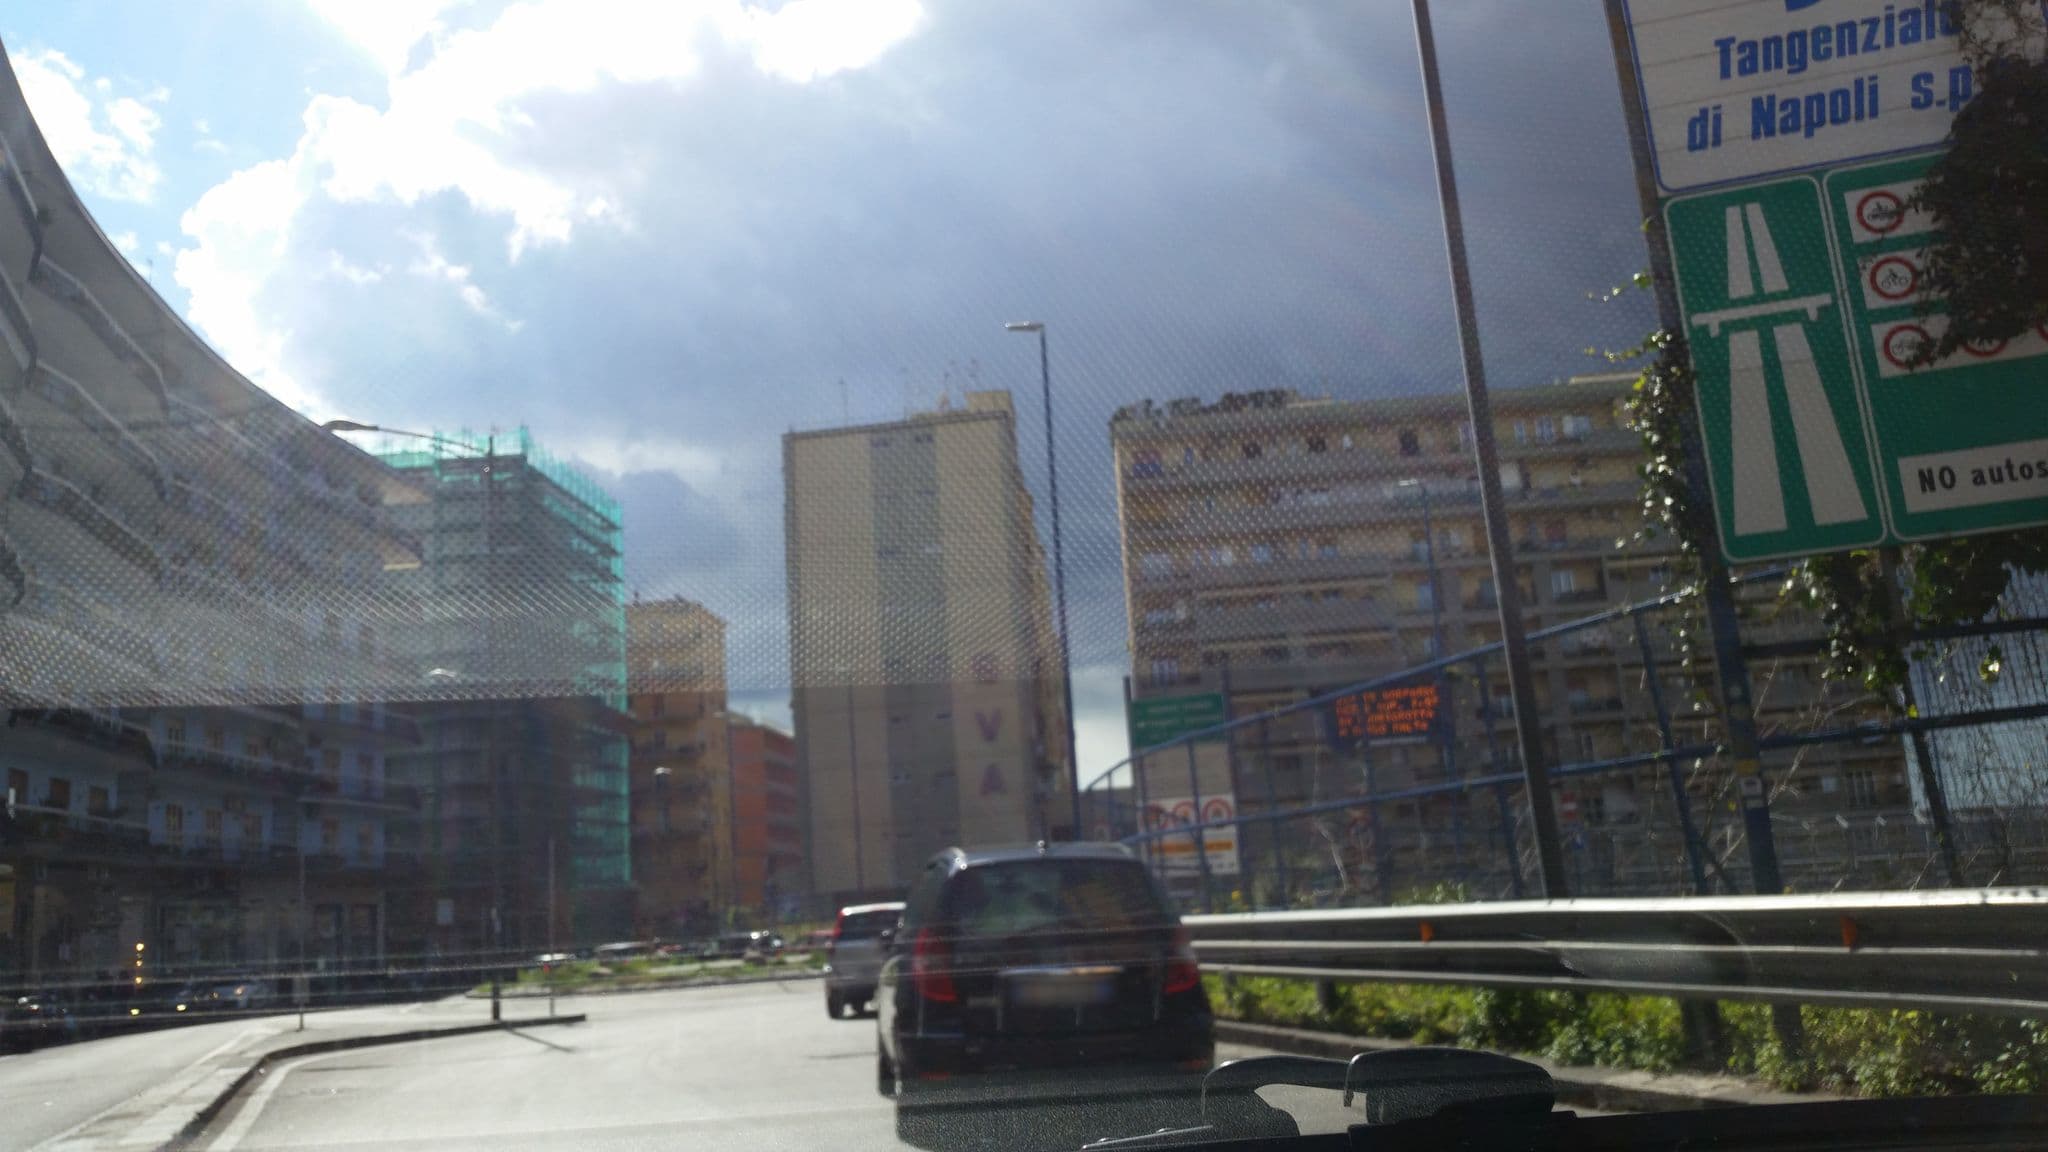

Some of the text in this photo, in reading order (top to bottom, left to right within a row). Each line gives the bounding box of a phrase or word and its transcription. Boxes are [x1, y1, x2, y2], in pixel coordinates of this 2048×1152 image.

[1687, 104, 1722, 152] di
[1751, 76, 1880, 140] Napoli
[1918, 465, 1957, 494] NO
